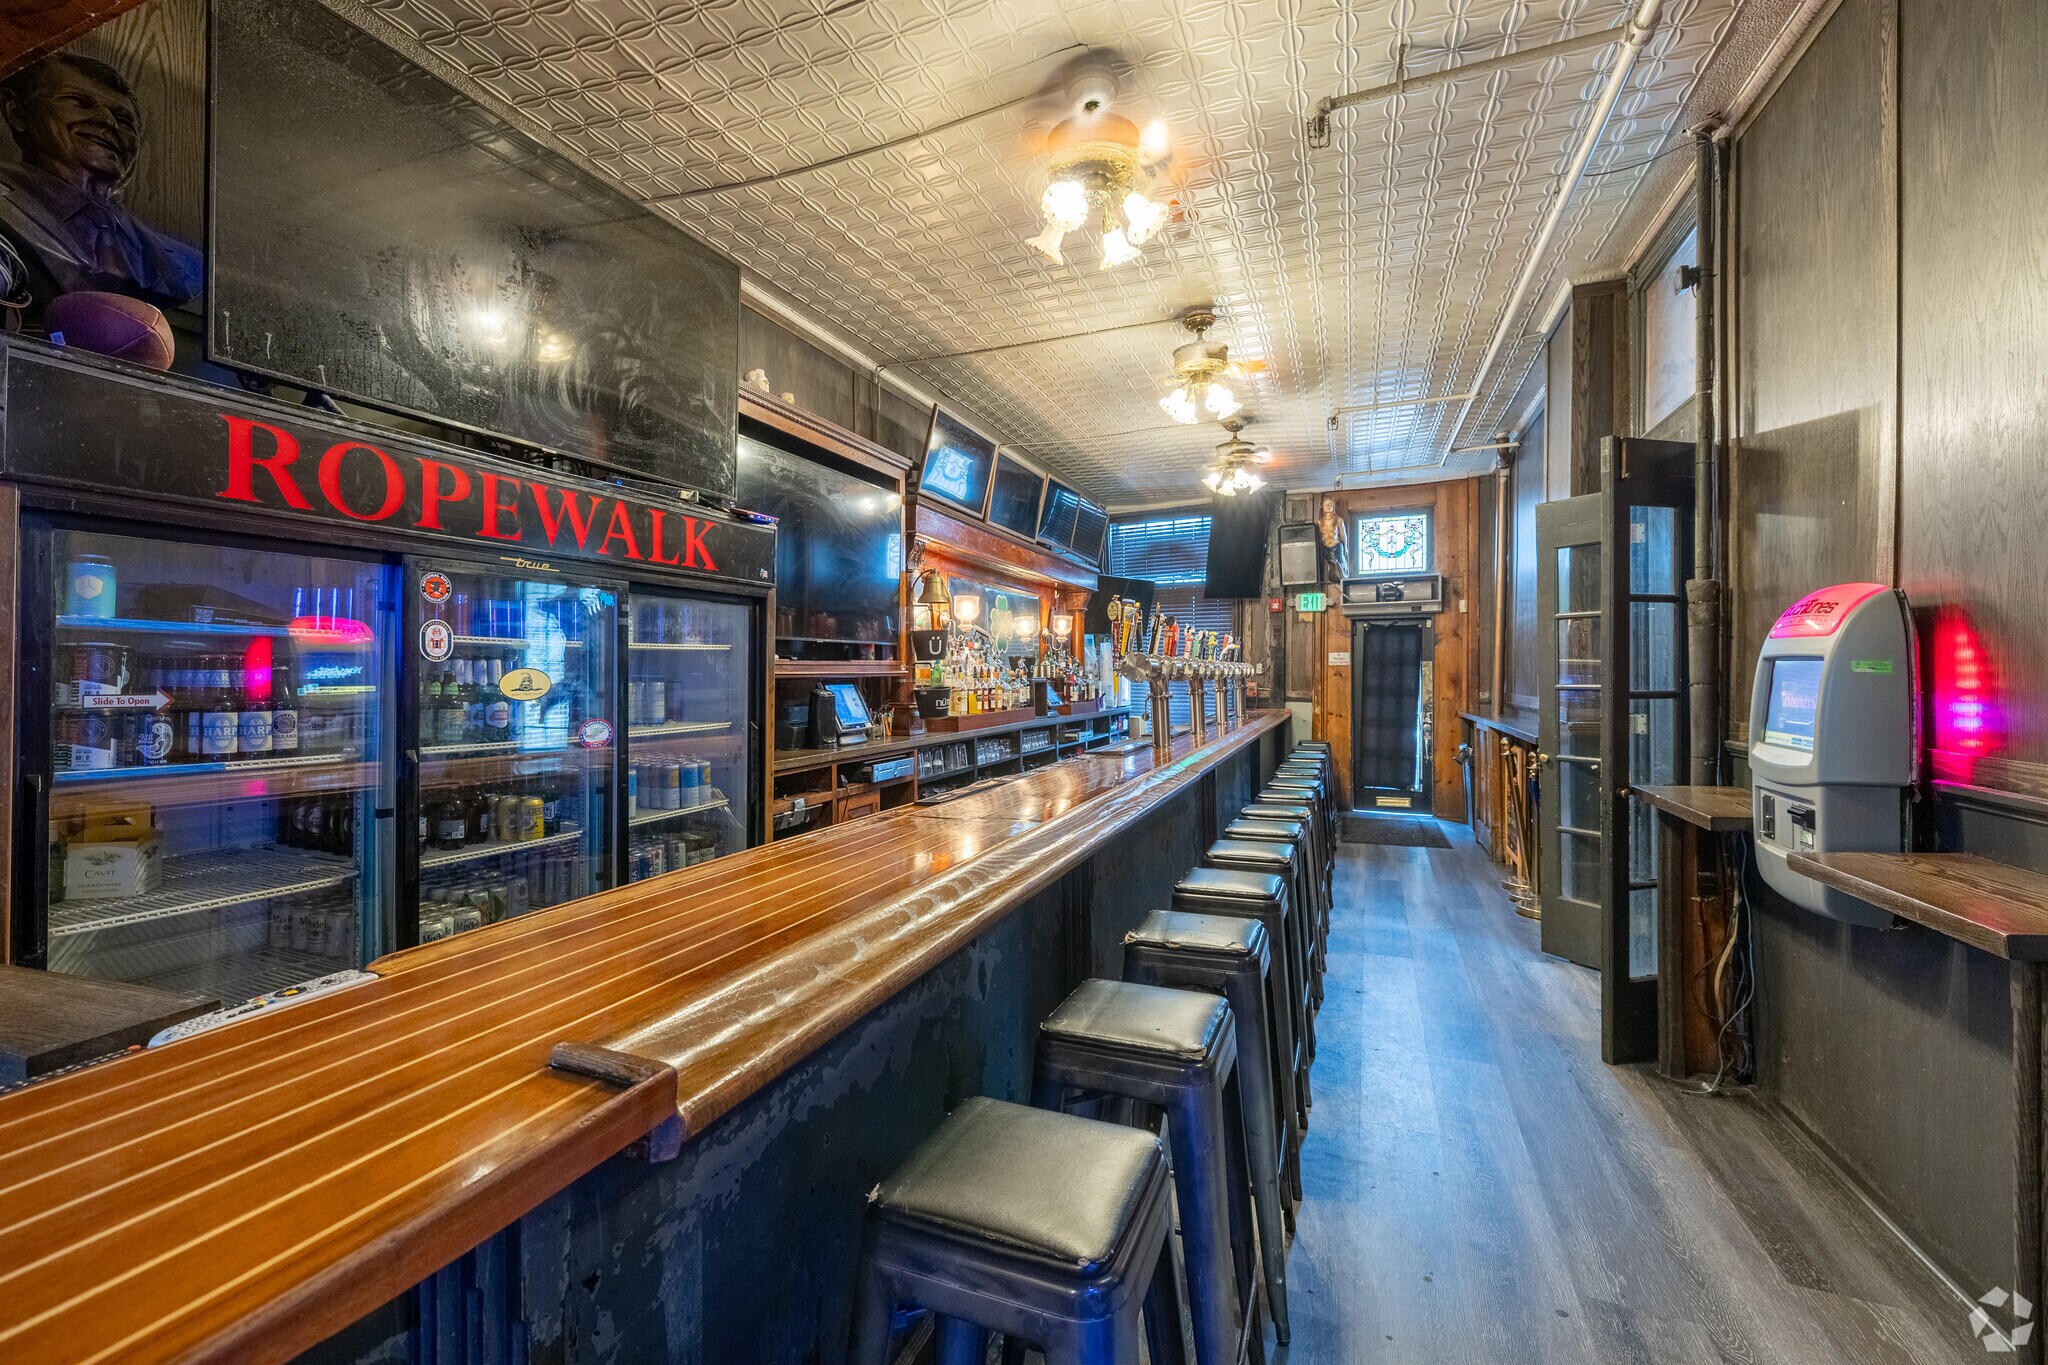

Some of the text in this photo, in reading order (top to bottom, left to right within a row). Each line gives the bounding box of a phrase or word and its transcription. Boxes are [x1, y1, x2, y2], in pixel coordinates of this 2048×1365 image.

[216, 413, 719, 571] ROPEWALK
[1301, 593, 1323, 610] EXIT
[929, 636, 942, 655] Ü
[92, 697, 150, 707] Slide To Open
[204, 726, 237, 736] HARP
[239, 725, 272, 735] HARP
